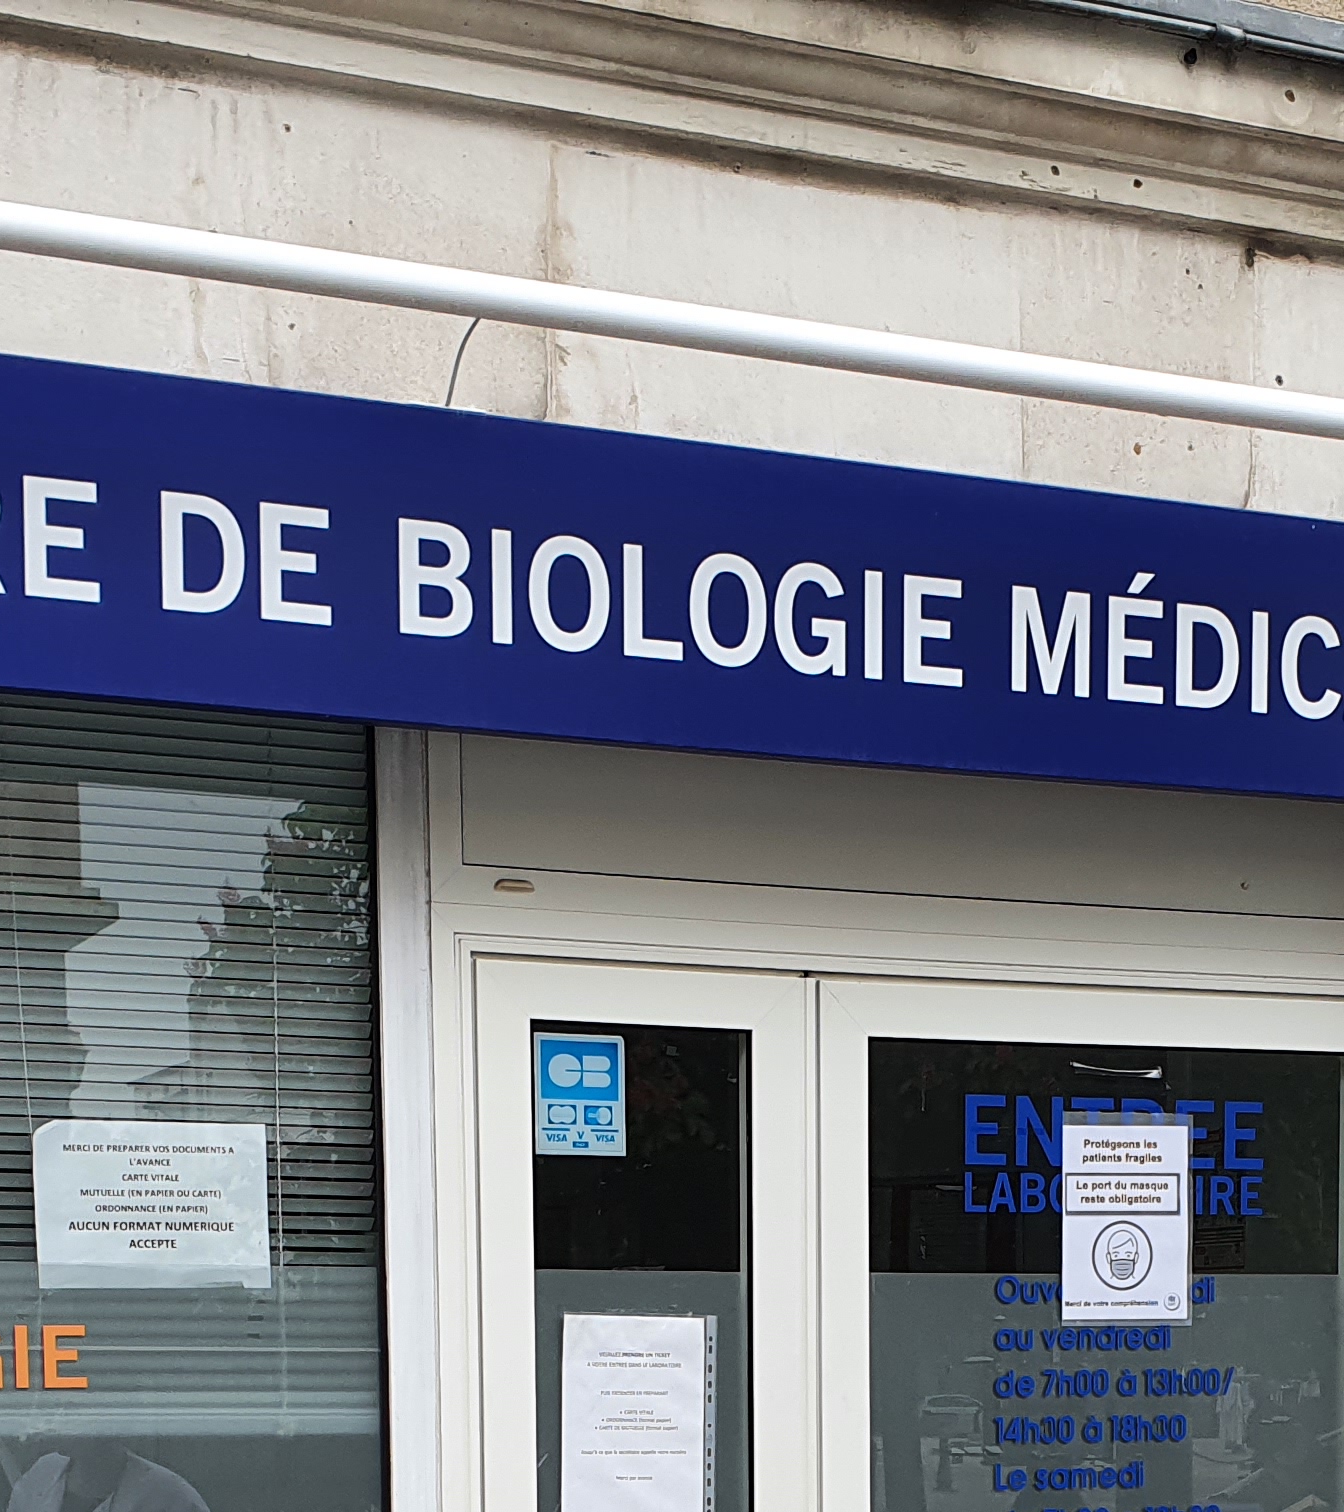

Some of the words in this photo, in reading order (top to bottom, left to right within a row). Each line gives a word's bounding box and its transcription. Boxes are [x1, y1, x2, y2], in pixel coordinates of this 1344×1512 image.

[160, 490, 332, 628] DE
[397, 516, 963, 687] BIOLOGIE
[546, 1134, 567, 1142] VISA
[596, 1134, 615, 1142] VISA
[964, 1094, 1264, 1170] ENEE
[63, 1144, 91, 1152] MERCI
[107, 1144, 150, 1153] PREPARER
[152, 1145, 170, 1153] VOS
[172, 1145, 226, 1154] DOCUMENTS
[228, 1146, 234, 1154] A
[1083, 1139, 1141, 1152] Protégeons
[1143, 1139, 1158, 1148] les
[129, 1158, 171, 1166] L'AVANCE
[1082, 1154, 1122, 1164] patients
[1125, 1153, 1162, 1164] fragiles
[122, 1174, 149, 1182] CARTE
[151, 1174, 179, 1182] VITALE
[80, 1189, 125, 1197] MUTUELLE
[128, 1189, 143, 1198] (EN
[145, 1189, 175, 1197] PAPIER
[177, 1189, 190, 1197] OU
[192, 1190, 221, 1198] CARTE)
[964, 1171, 1263, 1216] LABIRE
[1076, 1181, 1089, 1190] Le
[1092, 1181, 1112, 1193] port
[1115, 1181, 1127, 1190] du
[1130, 1182, 1169, 1194] masque
[1081, 1195, 1105, 1203] reste
[1109, 1195, 1162, 1205] obligatoire
[95, 1205, 156, 1213] ORDONNANCE
[159, 1205, 174, 1214] (EN
[176, 1205, 208, 1214] PAPIER)
[69, 1222, 110, 1231] AUCUN
[113, 1222, 162, 1232] FORMAT
[165, 1222, 235, 1233] NUMERIQUE
[129, 1239, 177, 1249] ACCEPTE
[995, 1274, 1063, 1304] Ouv
[994, 1328, 1034, 1351] au
[1043, 1326, 1171, 1351] vendredi
[994, 1370, 1036, 1398] de
[1043, 1369, 1110, 1398] 7h00
[1118, 1367, 1138, 1398] à
[1144, 1366, 1236, 1398] 13h00/
[994, 1415, 1075, 1445] 14h30
[1084, 1416, 1104, 1444] à
[1110, 1414, 1188, 1443] 18h30
[995, 1463, 1028, 1492] Le
[1034, 1461, 1145, 1491] samedi
